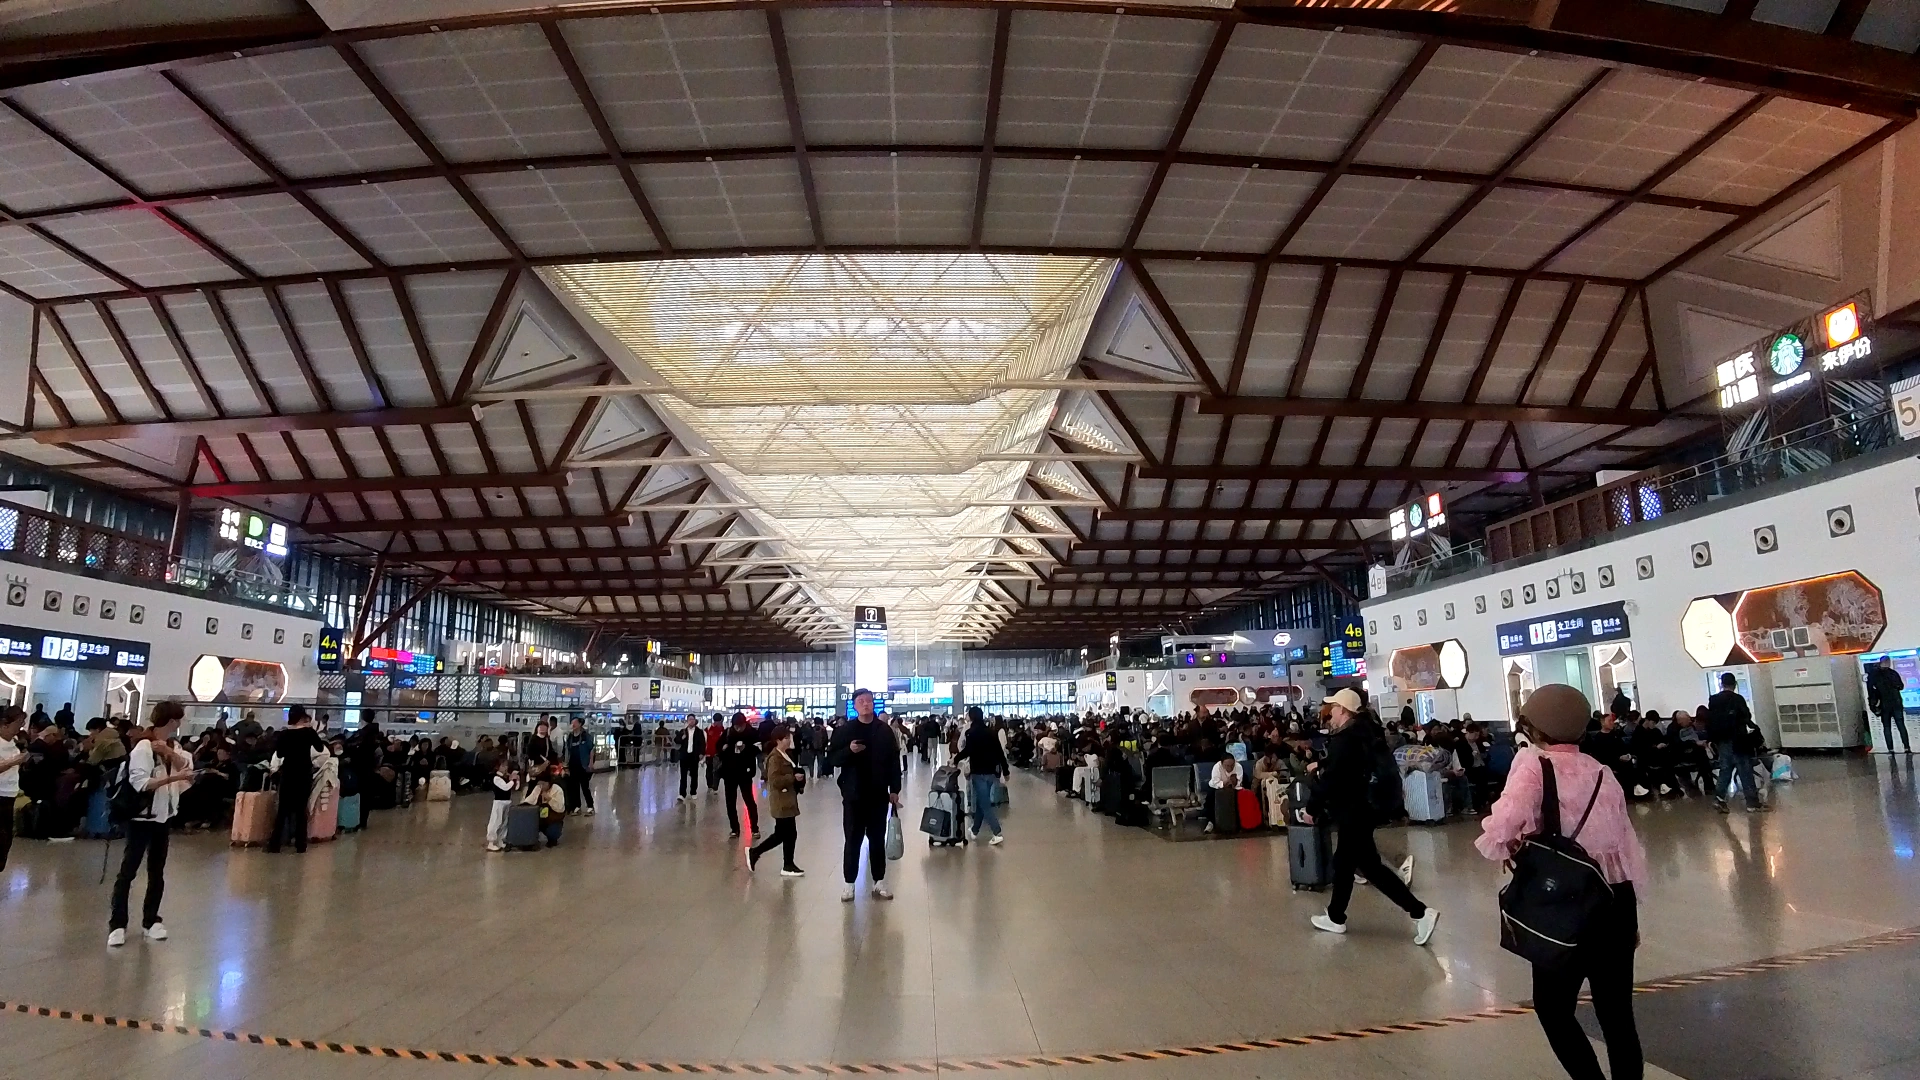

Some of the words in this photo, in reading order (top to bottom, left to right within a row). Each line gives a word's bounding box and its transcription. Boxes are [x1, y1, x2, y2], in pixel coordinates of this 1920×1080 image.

[1821, 336, 1873, 372] 来伊份
[1716, 350, 1755, 387] 庆
[1720, 374, 1759, 409] 小
[1345, 622, 1363, 637] 4B
[1557, 617, 1584, 632] 女卫生间
[78, 642, 110, 656] 男卫生间
[320, 634, 338, 649] 4A
